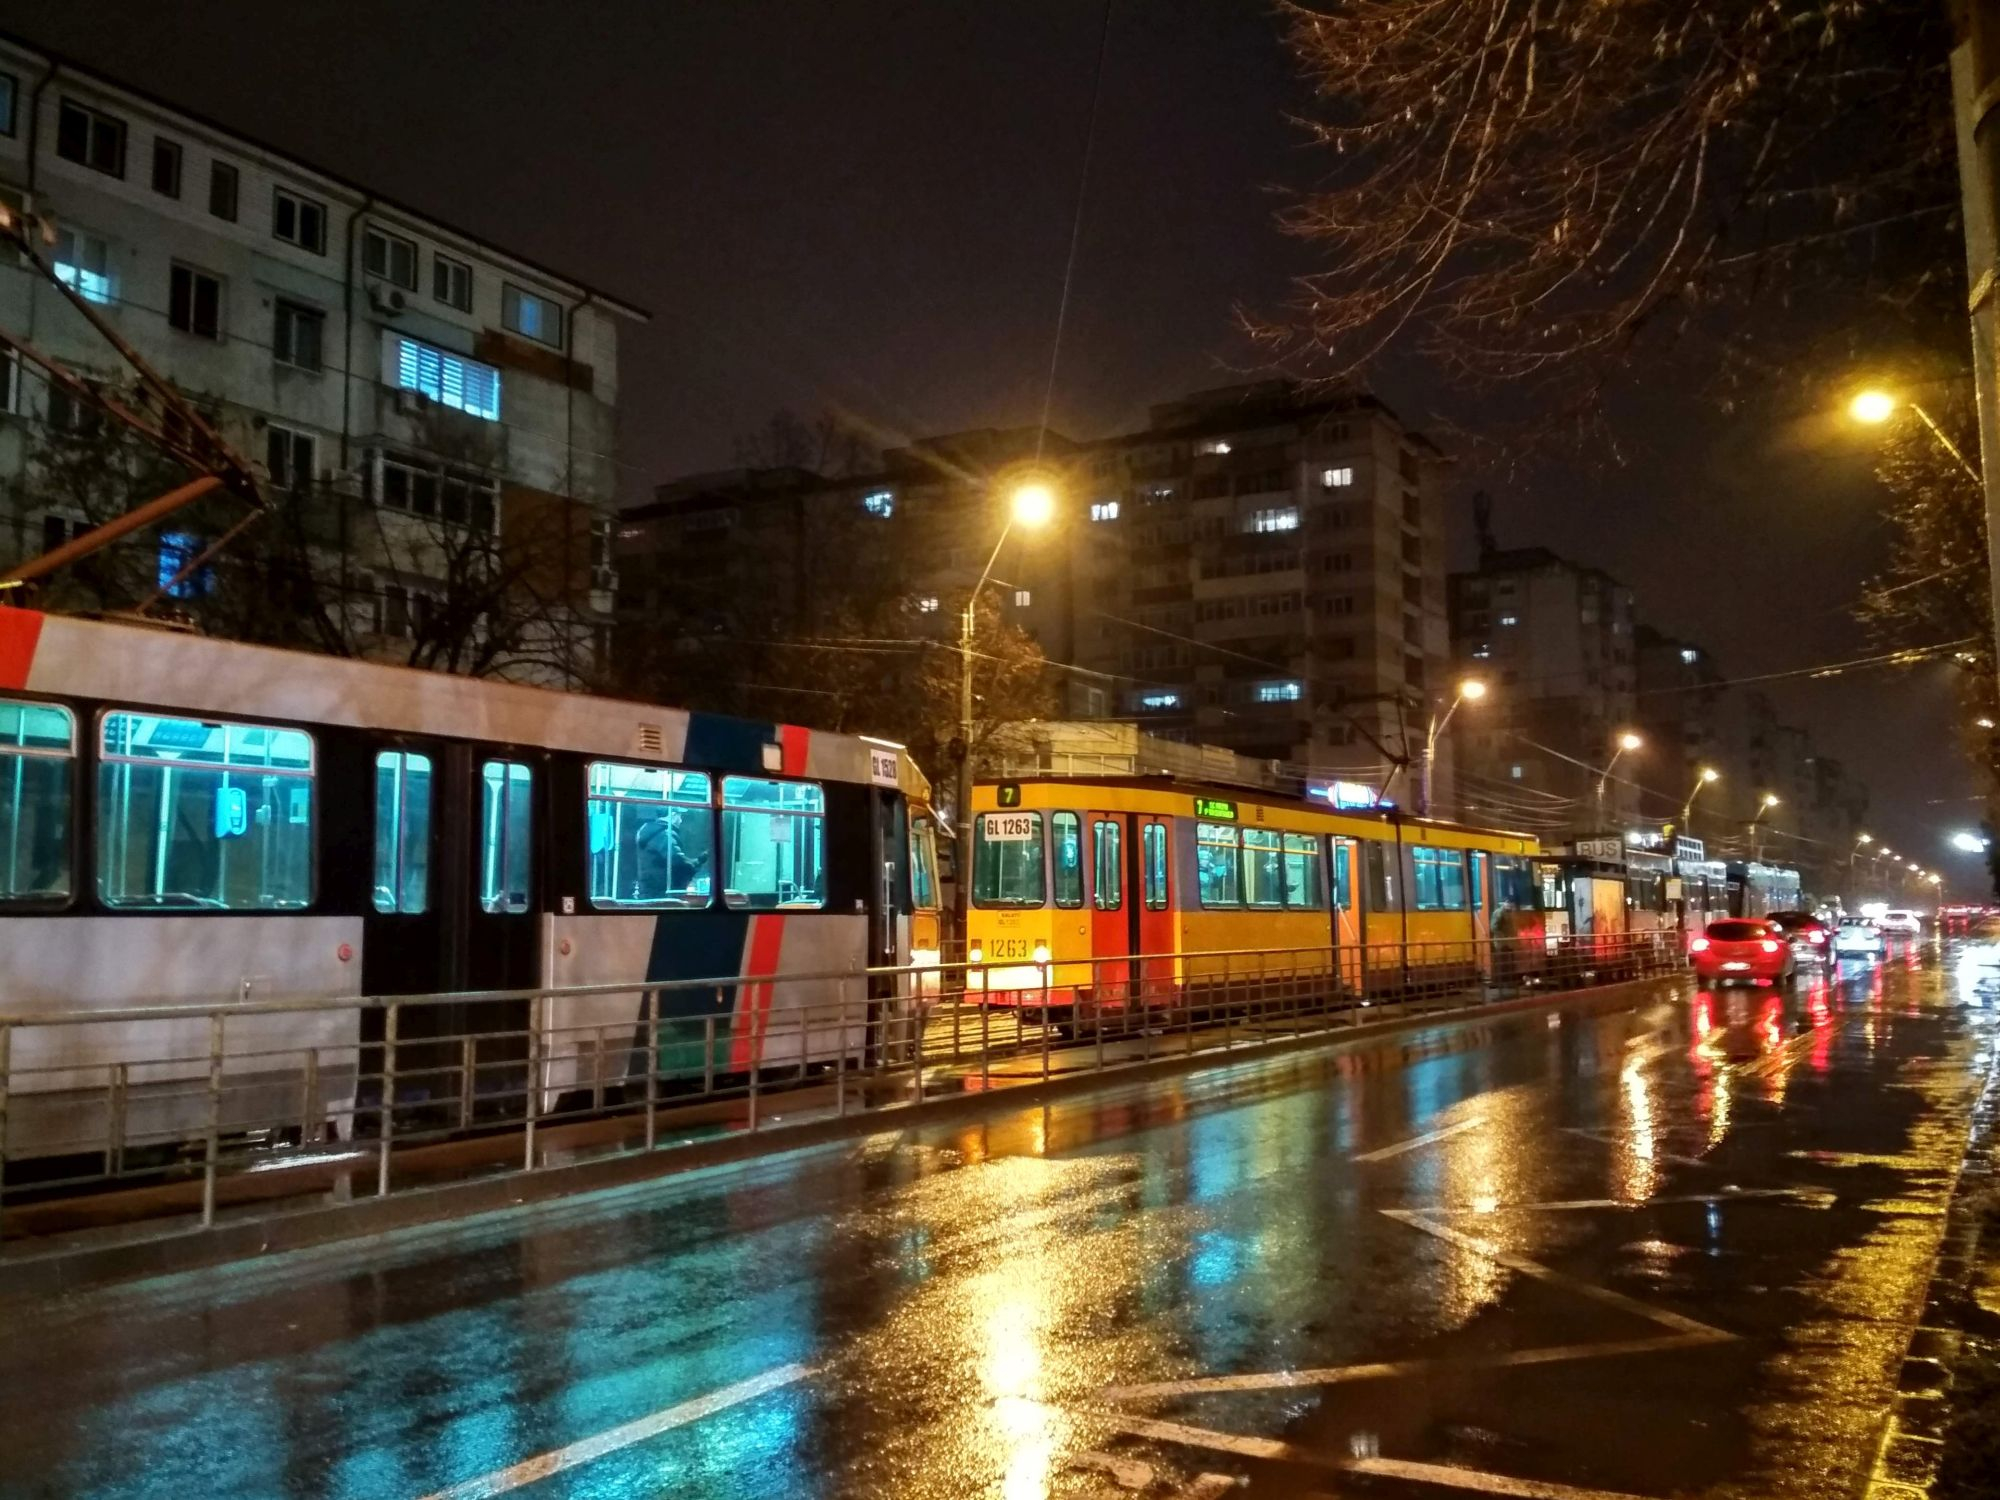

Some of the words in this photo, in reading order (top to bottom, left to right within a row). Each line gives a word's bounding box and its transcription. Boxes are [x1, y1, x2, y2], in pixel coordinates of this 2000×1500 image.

[1004, 788, 1013, 803] 7
[987, 819, 1000, 835] GL
[1002, 818, 1030, 835] 1263
[1580, 842, 1617, 856] BUS
[990, 938, 1027, 958] 1263
